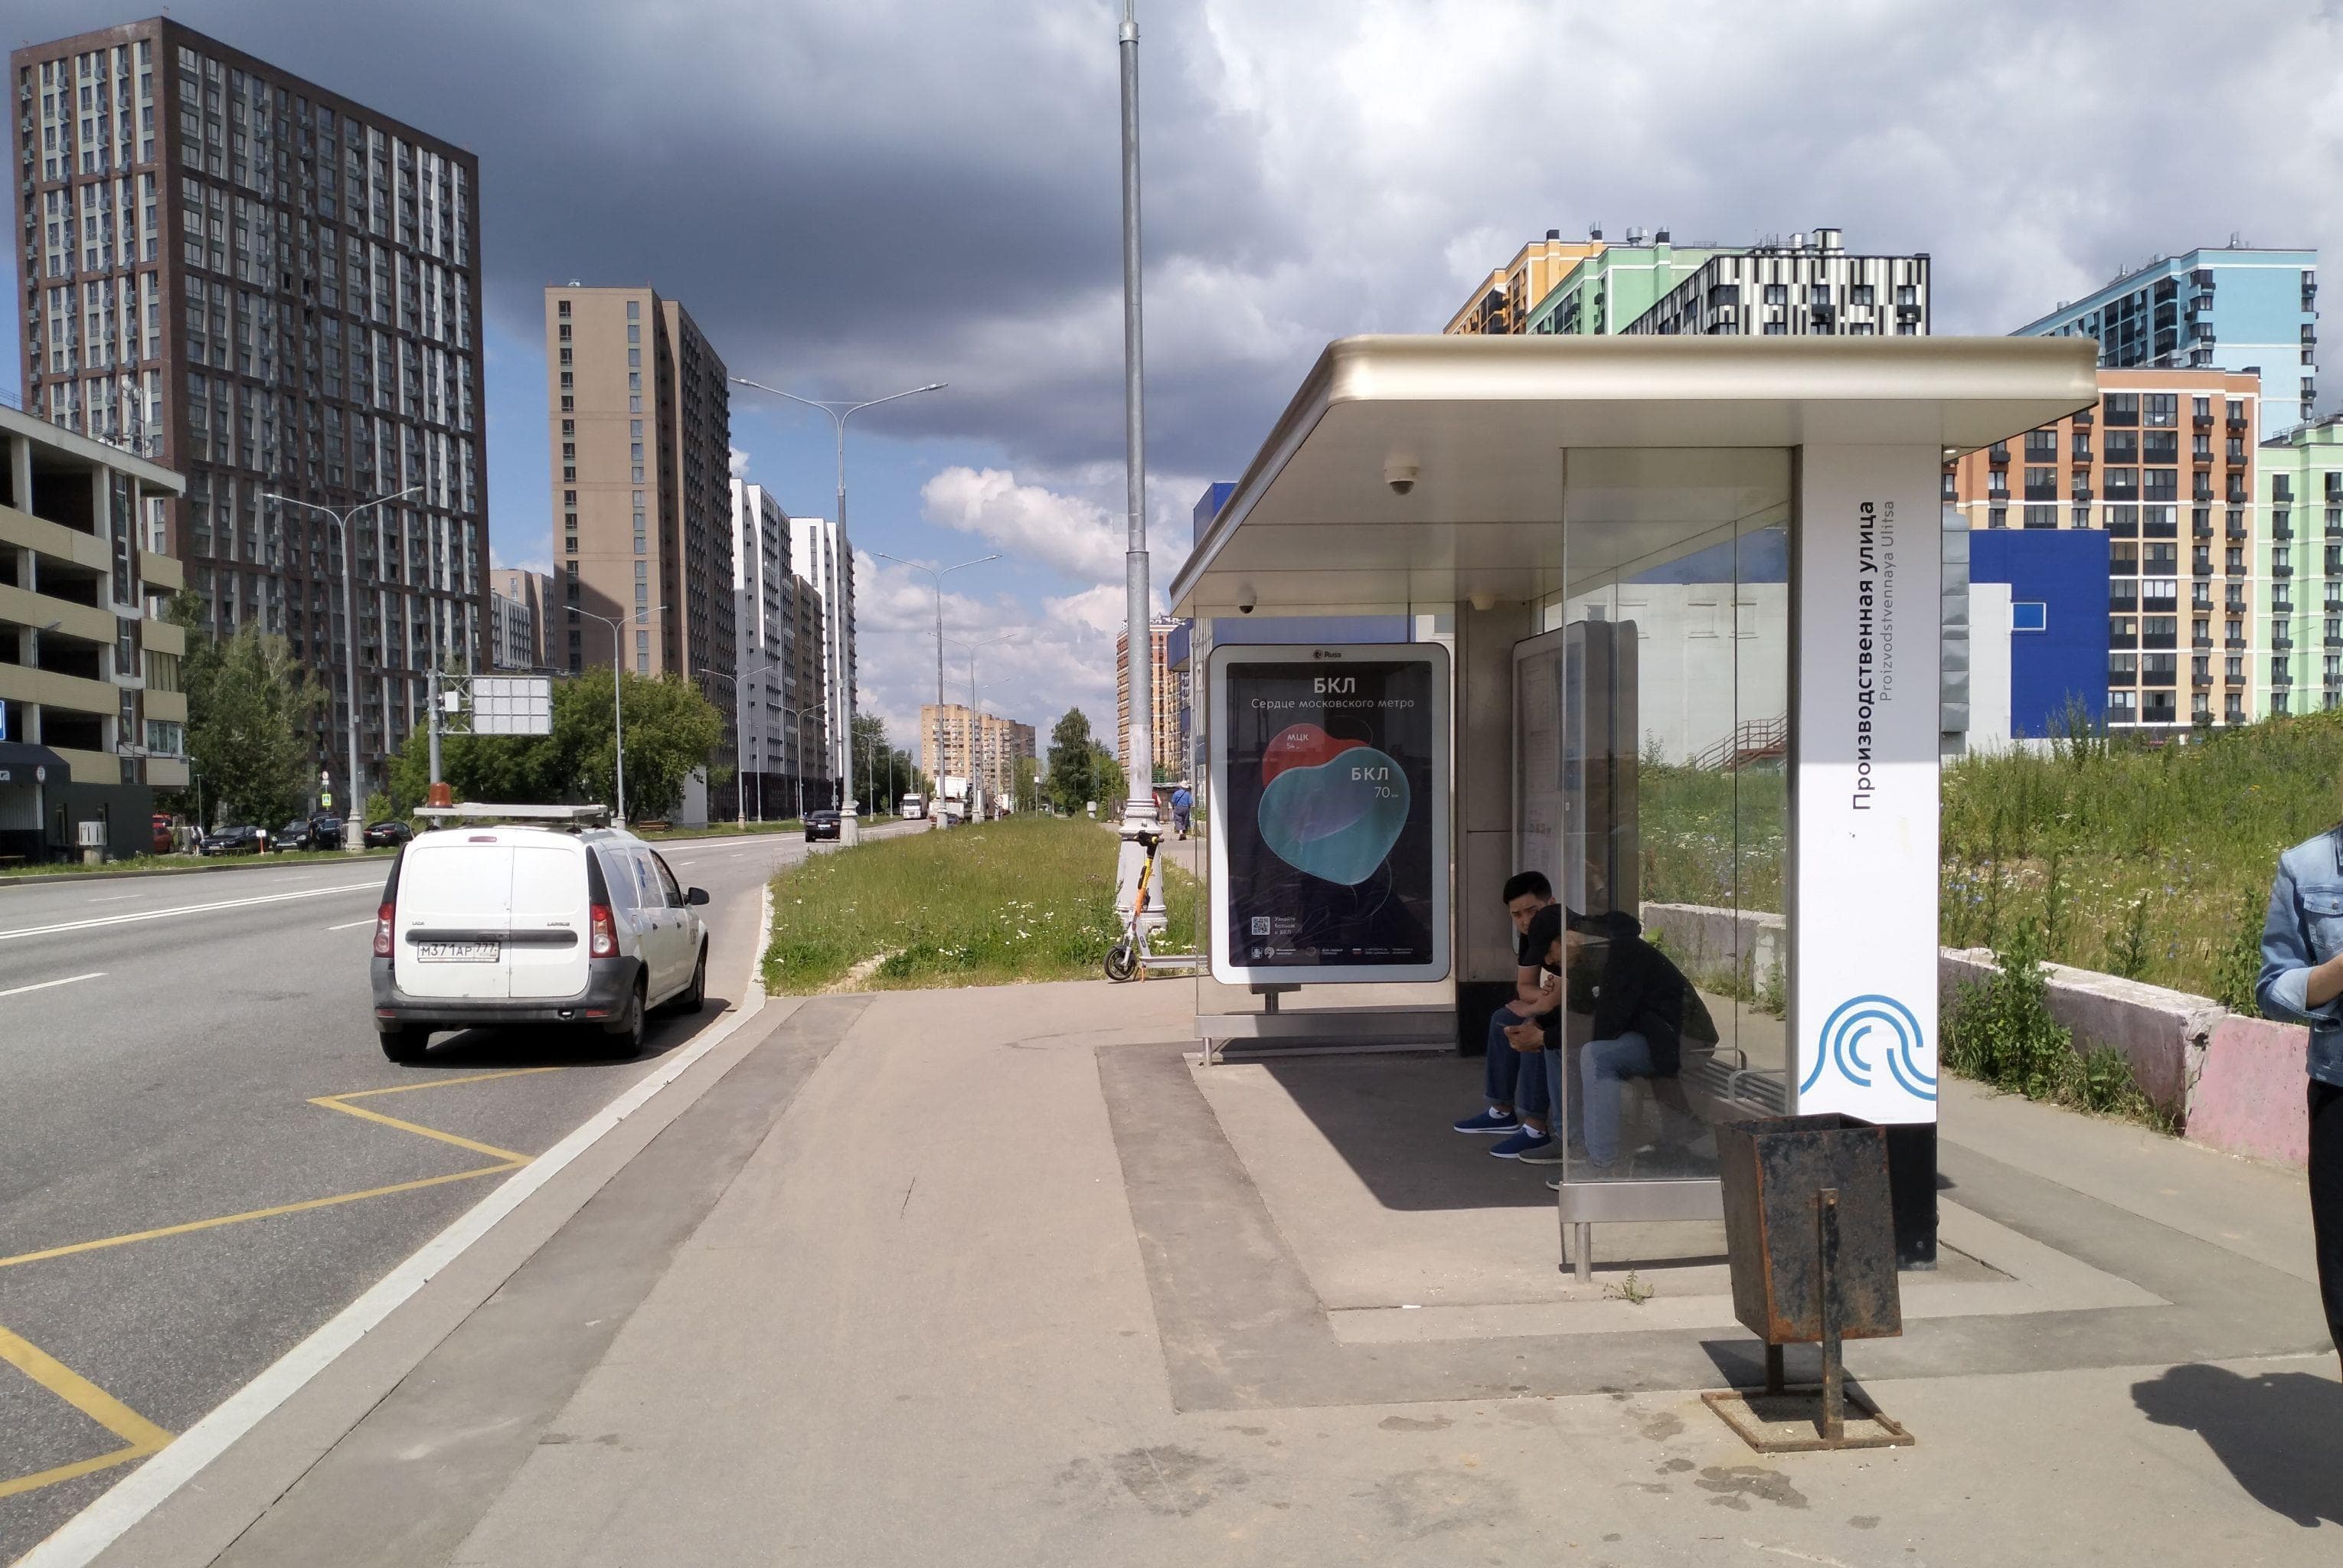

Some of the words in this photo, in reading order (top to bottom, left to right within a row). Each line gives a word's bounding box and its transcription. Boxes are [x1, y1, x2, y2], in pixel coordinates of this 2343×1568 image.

[1860, 501, 1877, 573] улица
[1881, 501, 1894, 547] Ulitsa
[1880, 552, 1896, 701] Proizvodstvennaya
[1313, 677, 1356, 694] БКЛ
[1853, 580, 1875, 809] Производственная
[1251, 698, 1295, 710] Сердце
[1299, 699, 1374, 709] московского
[1377, 700, 1414, 709] метро
[1351, 767, 1389, 780] БКЛ
[1374, 786, 1390, 798] 70
